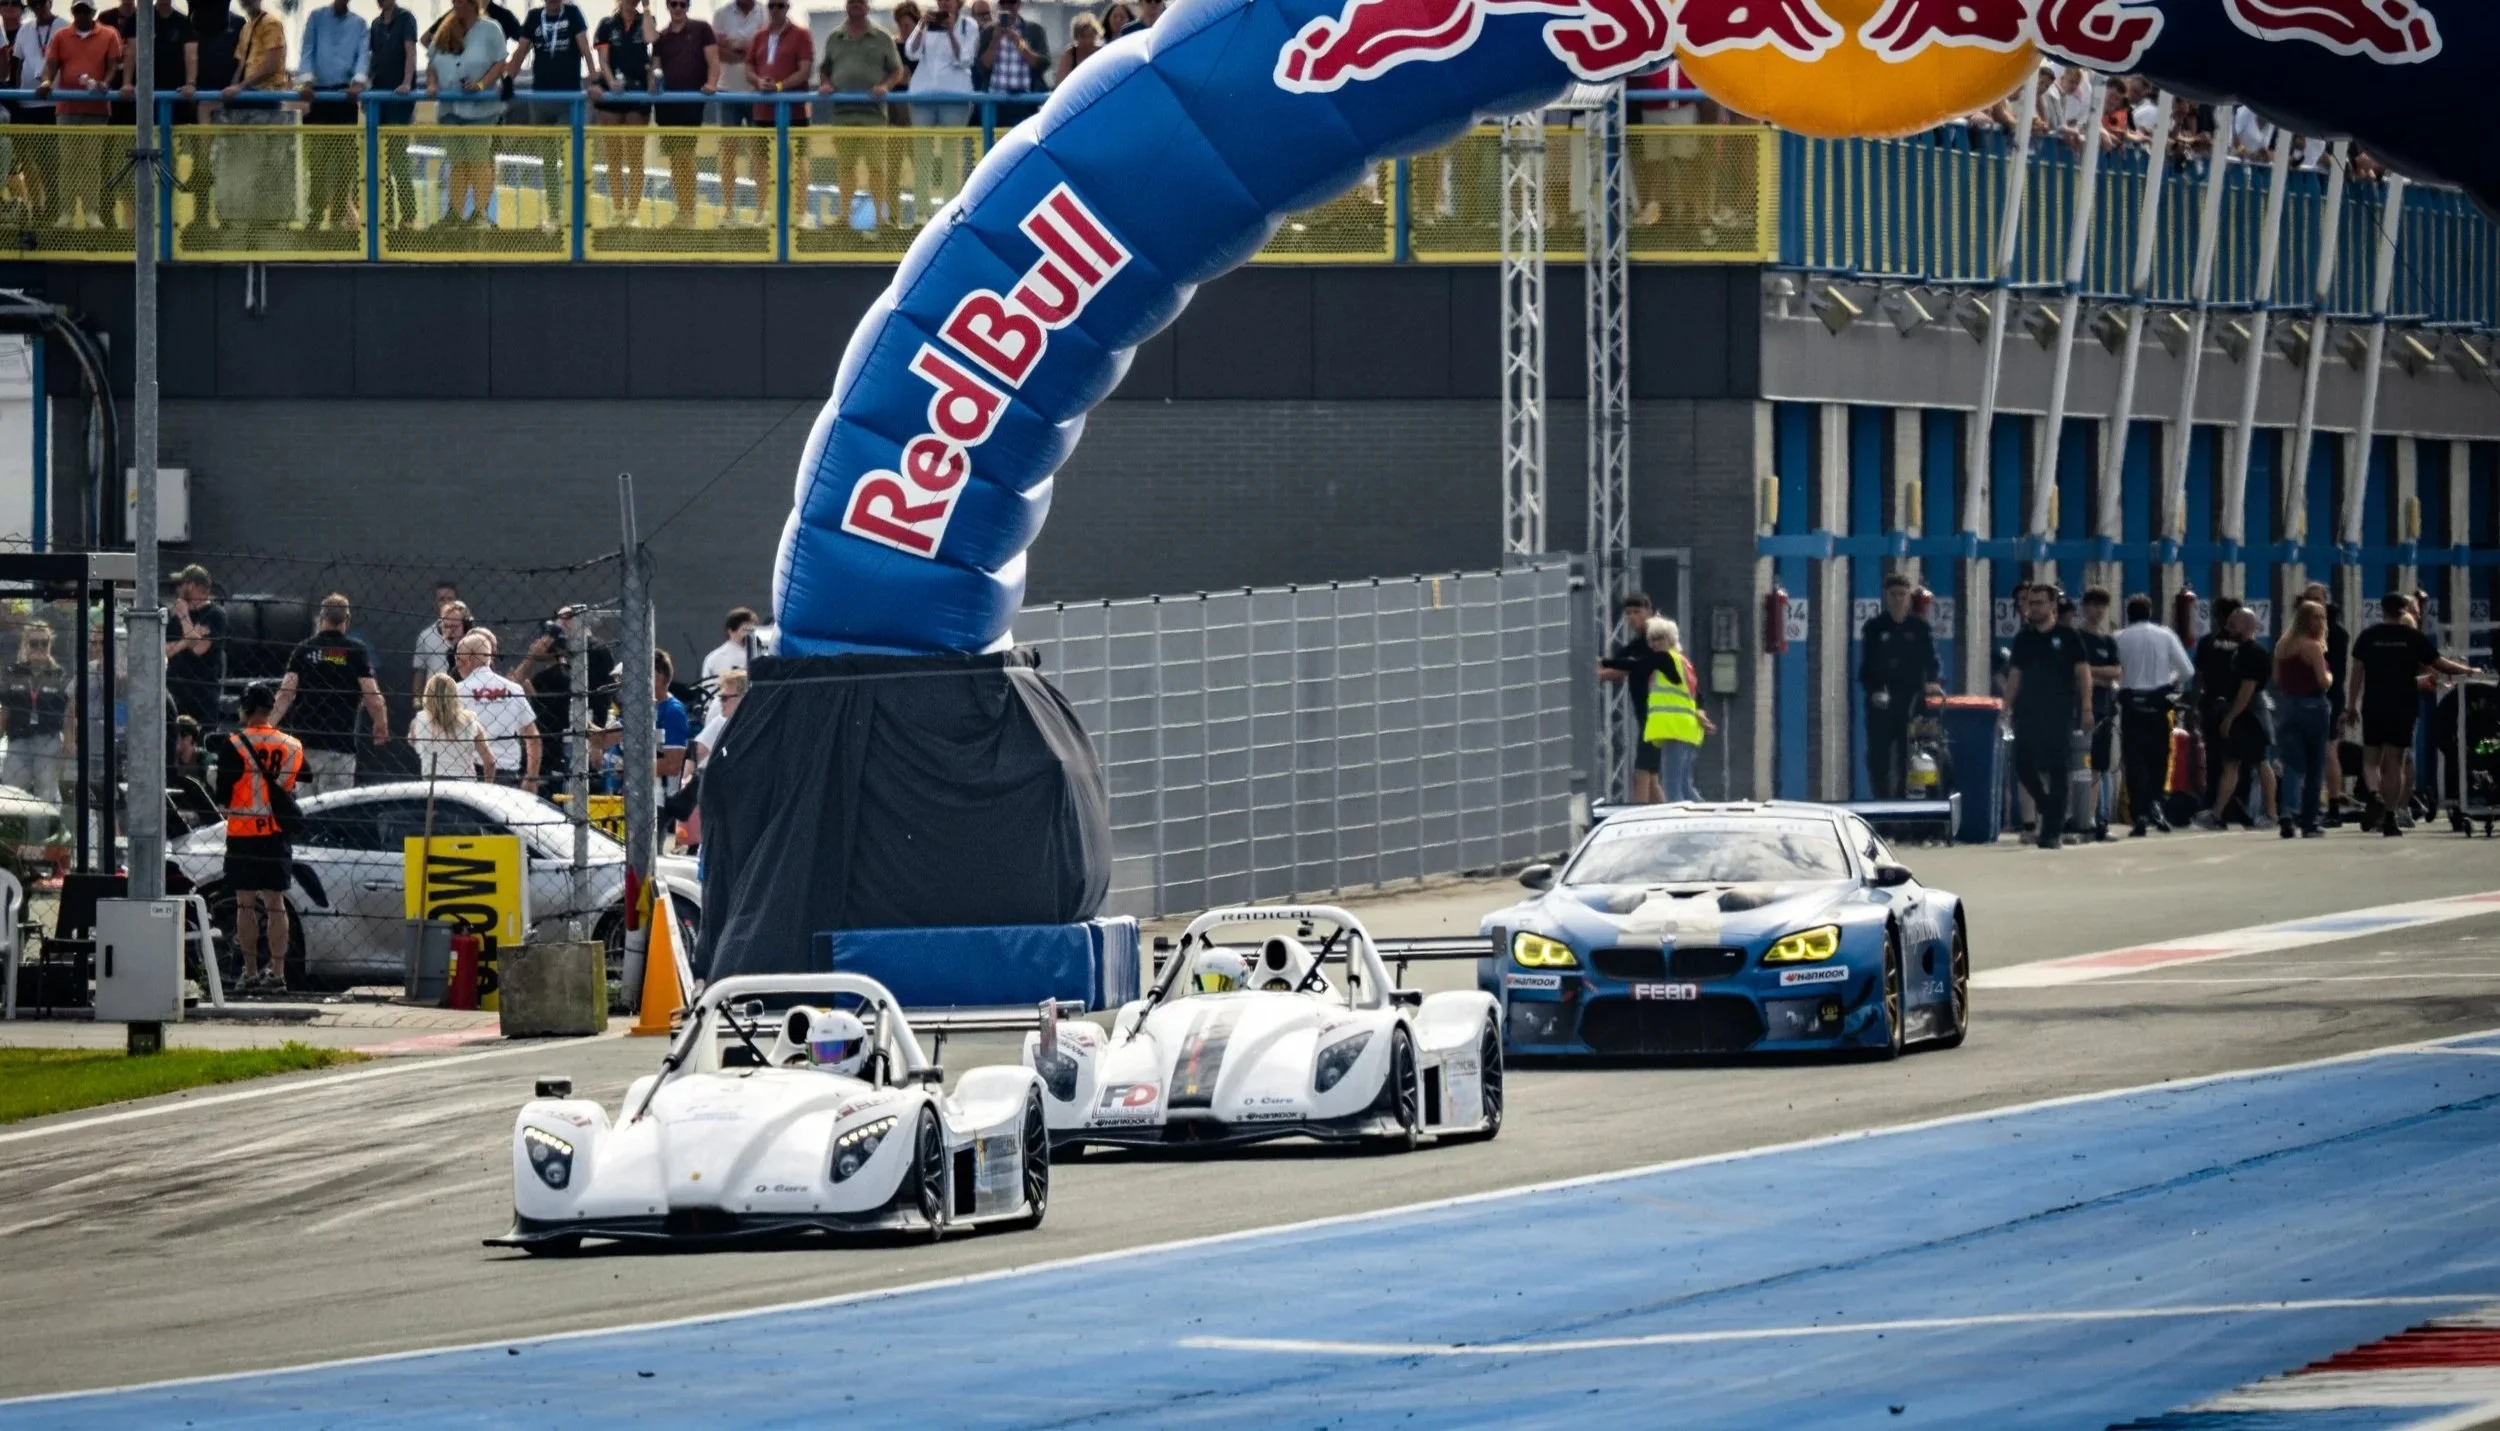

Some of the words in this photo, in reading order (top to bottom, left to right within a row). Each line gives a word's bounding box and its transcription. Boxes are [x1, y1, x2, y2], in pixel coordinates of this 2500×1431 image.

[848, 350, 1003, 554] Red
[946, 189, 1125, 384] Bull
[1222, 910, 1317, 921] RADICAL
[1100, 1083, 1158, 1108] FD
